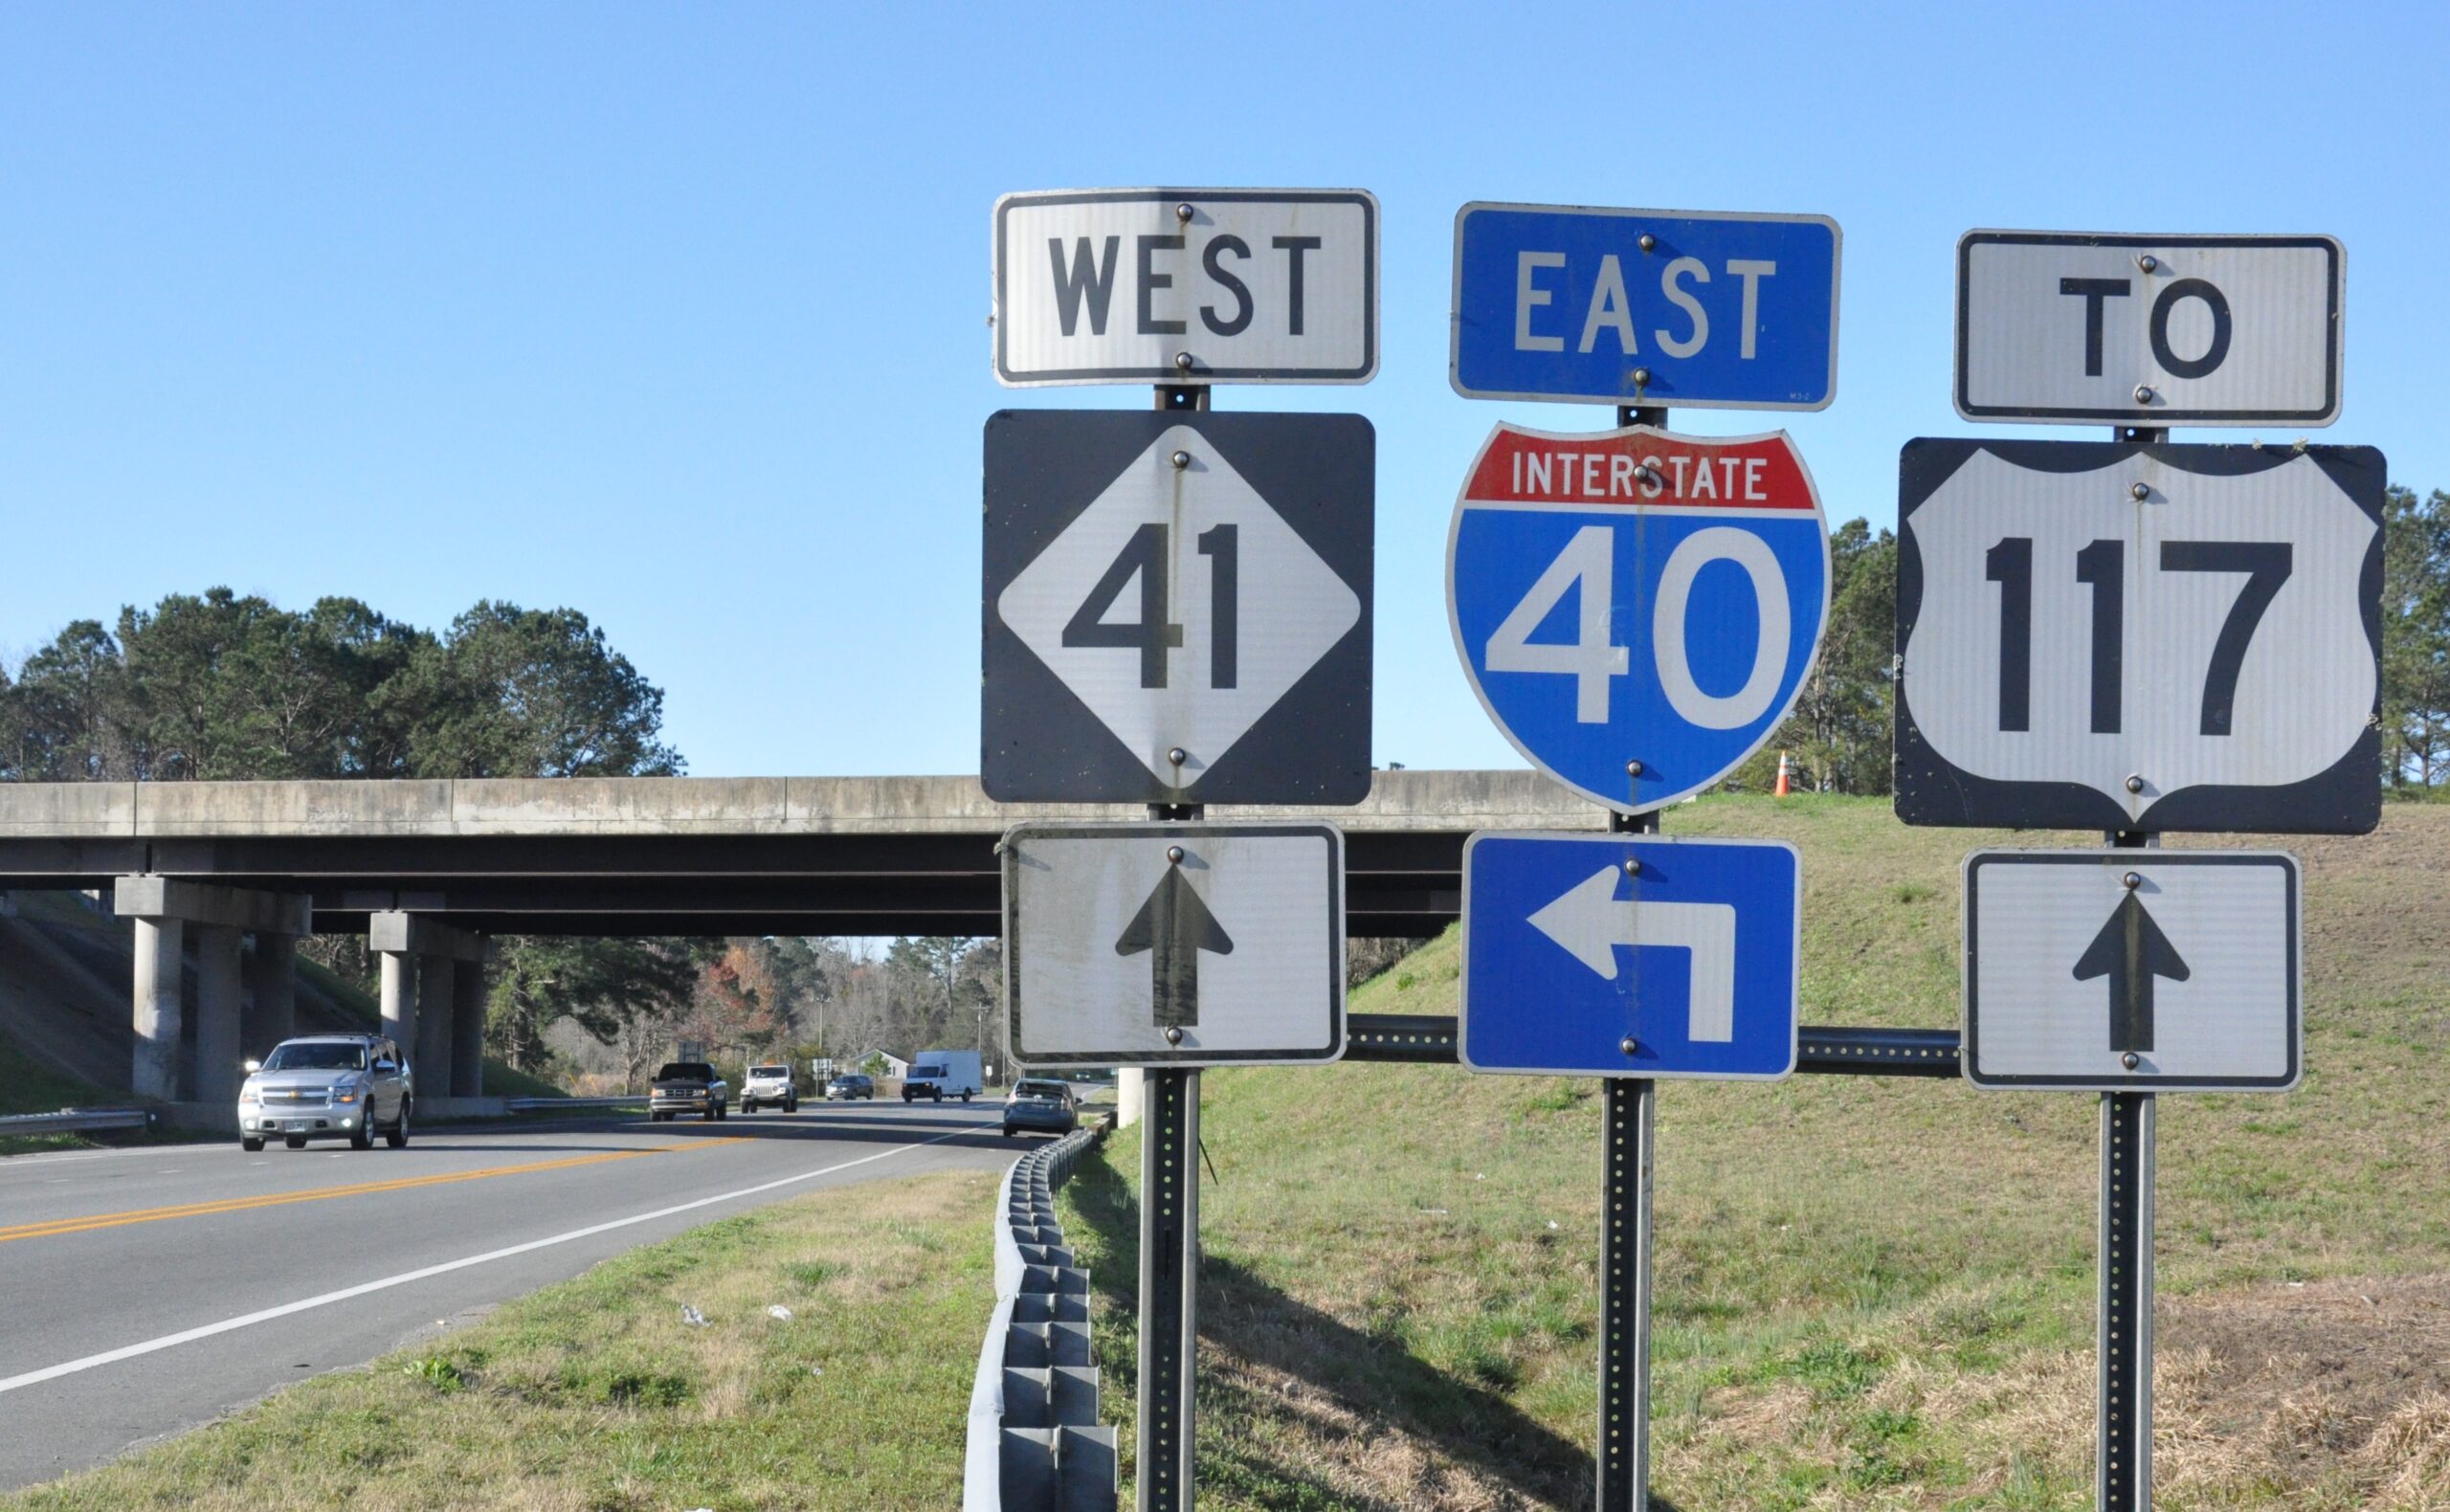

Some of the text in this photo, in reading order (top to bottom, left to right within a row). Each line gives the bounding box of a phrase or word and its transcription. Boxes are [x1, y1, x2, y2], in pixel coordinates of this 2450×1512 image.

[1049, 234, 1322, 337] WEST
[1515, 251, 1776, 359] EAST
[2060, 278, 2232, 379] TO
[1512, 452, 1767, 500] INTERSTATE
[1061, 523, 1238, 689] 41
[1485, 525, 1791, 730] 40
[1986, 537, 2293, 736] 117
